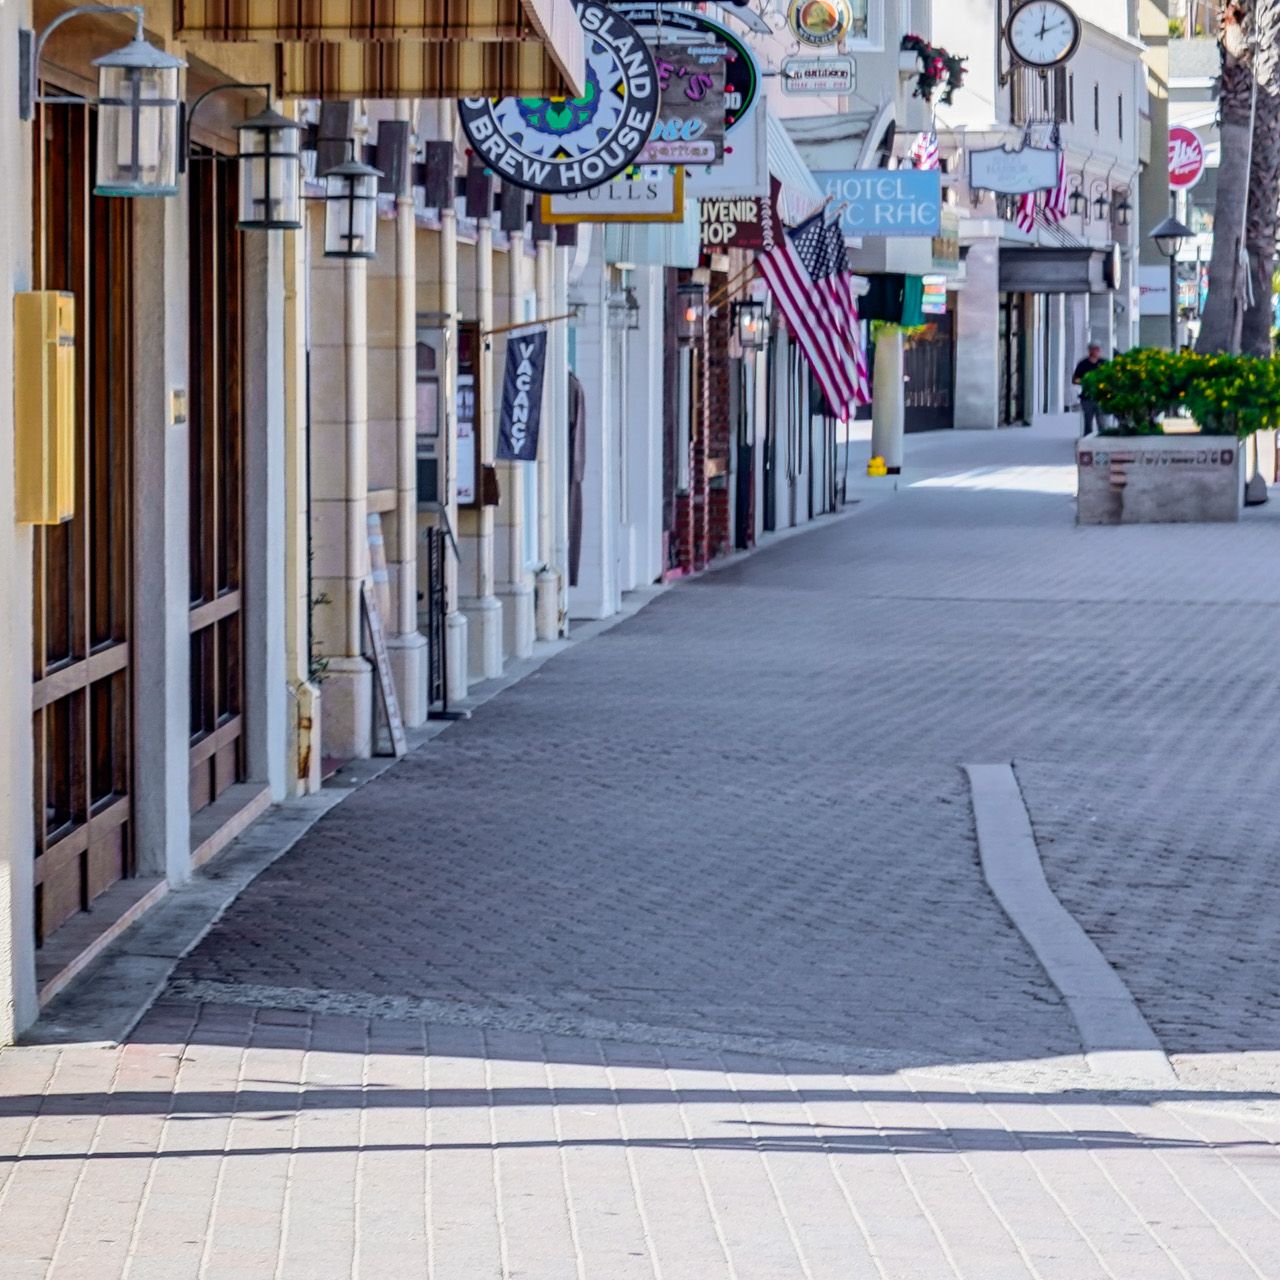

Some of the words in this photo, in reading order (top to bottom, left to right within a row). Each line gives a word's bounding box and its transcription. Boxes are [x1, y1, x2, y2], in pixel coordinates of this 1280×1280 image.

[574, 2, 652, 99] ISLAND
[650, 116, 708, 141] ose
[468, 115, 552, 186] BREW
[559, 106, 651, 187] HOUSE
[825, 177, 916, 201] HOTEL
[700, 201, 759, 223] UVENIR
[700, 222, 737, 245] HOP
[510, 343, 534, 455] VACANCY
